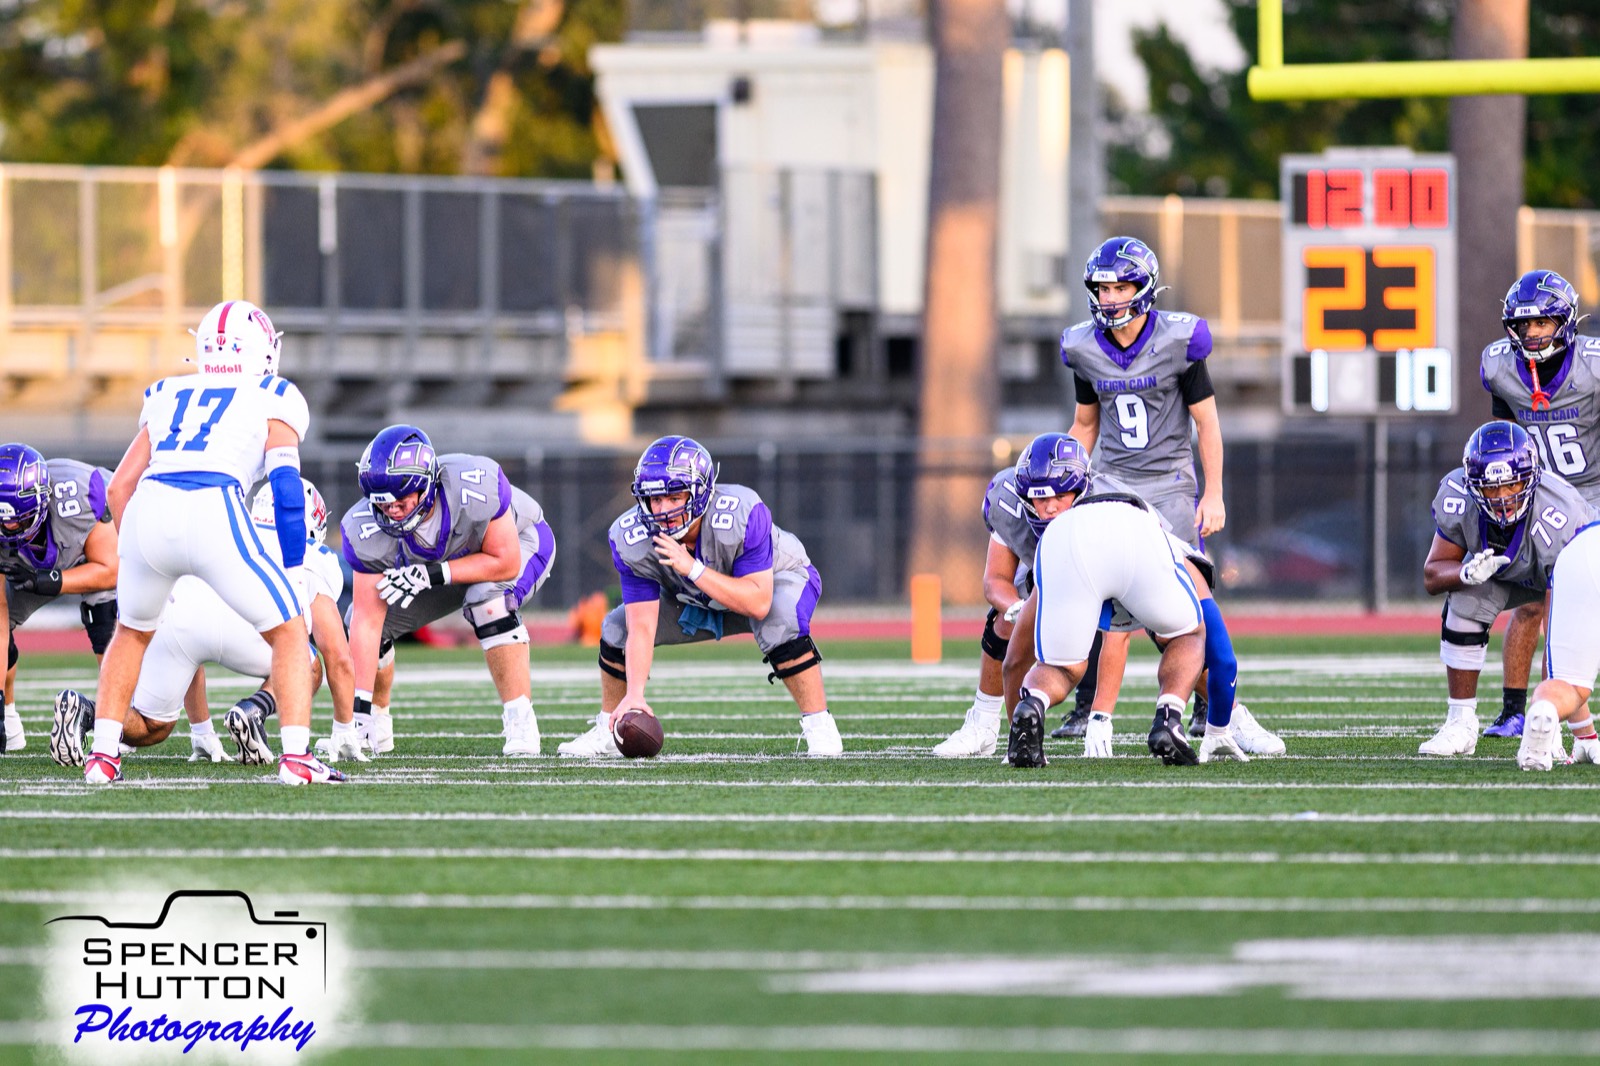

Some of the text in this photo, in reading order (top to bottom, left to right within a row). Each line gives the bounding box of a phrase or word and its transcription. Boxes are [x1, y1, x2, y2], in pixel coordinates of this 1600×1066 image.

[1302, 245, 1436, 352] 23
[204, 364, 242, 374] Riddell
[1097, 376, 1157, 392] REIGN CAIN
[1396, 348, 1451, 411] 10
[155, 387, 236, 452] 17
[1114, 393, 1150, 449] 9
[1518, 407, 1579, 422] REIGN CAIN
[1526, 423, 1588, 476] 16
[54, 480, 82, 518] 63
[460, 468, 487, 505] 74
[711, 495, 740, 530] 69
[1530, 506, 1568, 548] 76
